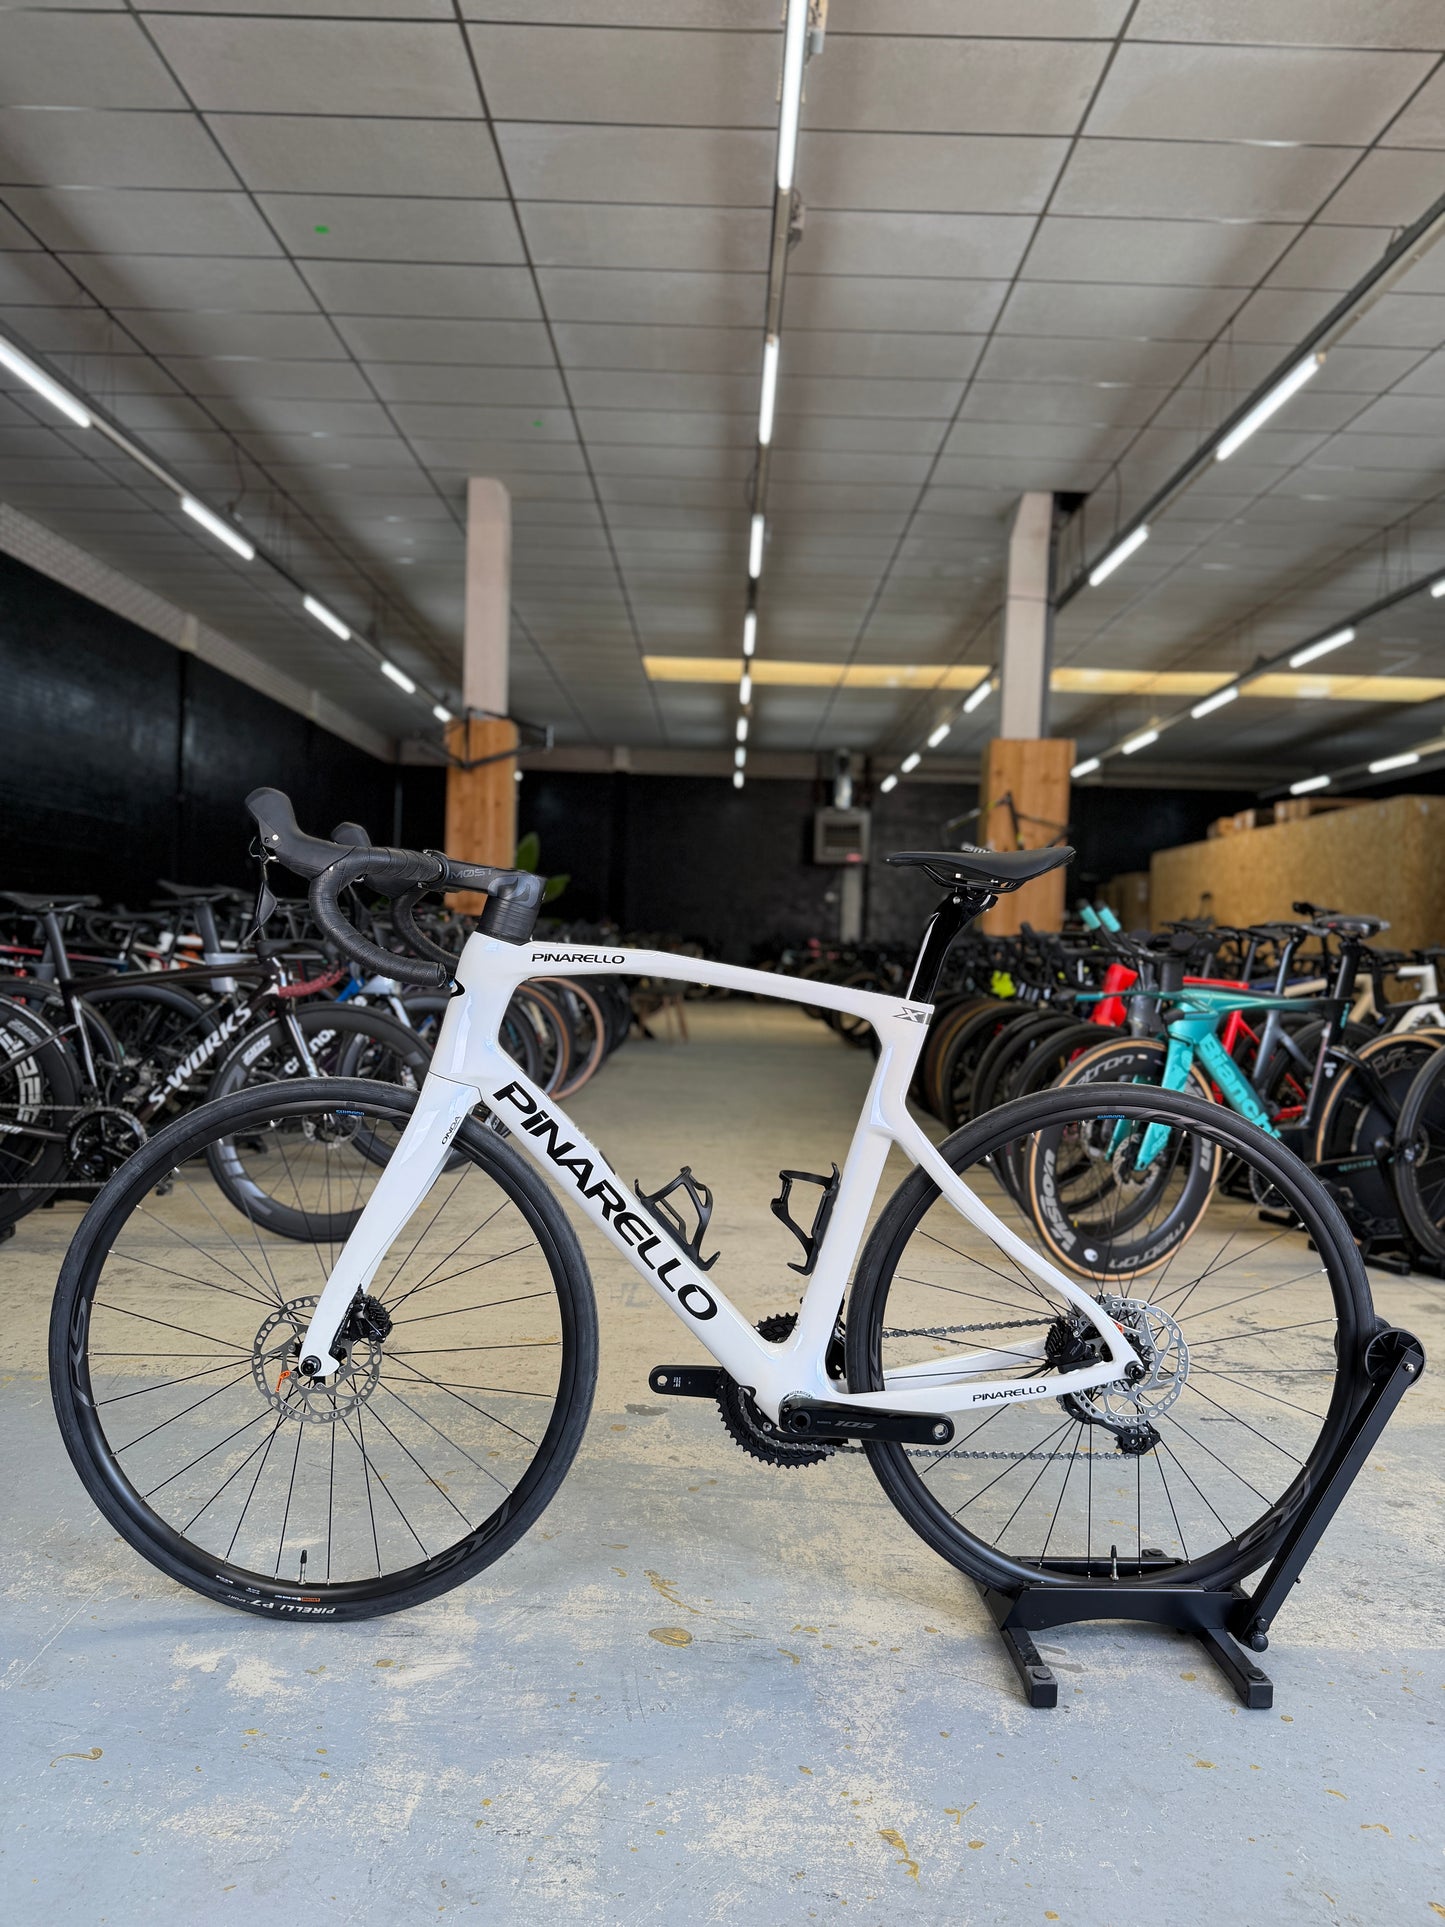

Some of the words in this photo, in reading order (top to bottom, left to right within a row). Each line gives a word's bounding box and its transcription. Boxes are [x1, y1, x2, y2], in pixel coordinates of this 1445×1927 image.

[149, 999, 252, 1112] S-WORKS
[441, 1116, 462, 1145] ONDA
[834, 1420, 878, 1429] 105
[249, 1599, 275, 1609] P7
[280, 1604, 337, 1614] PIRELLI
